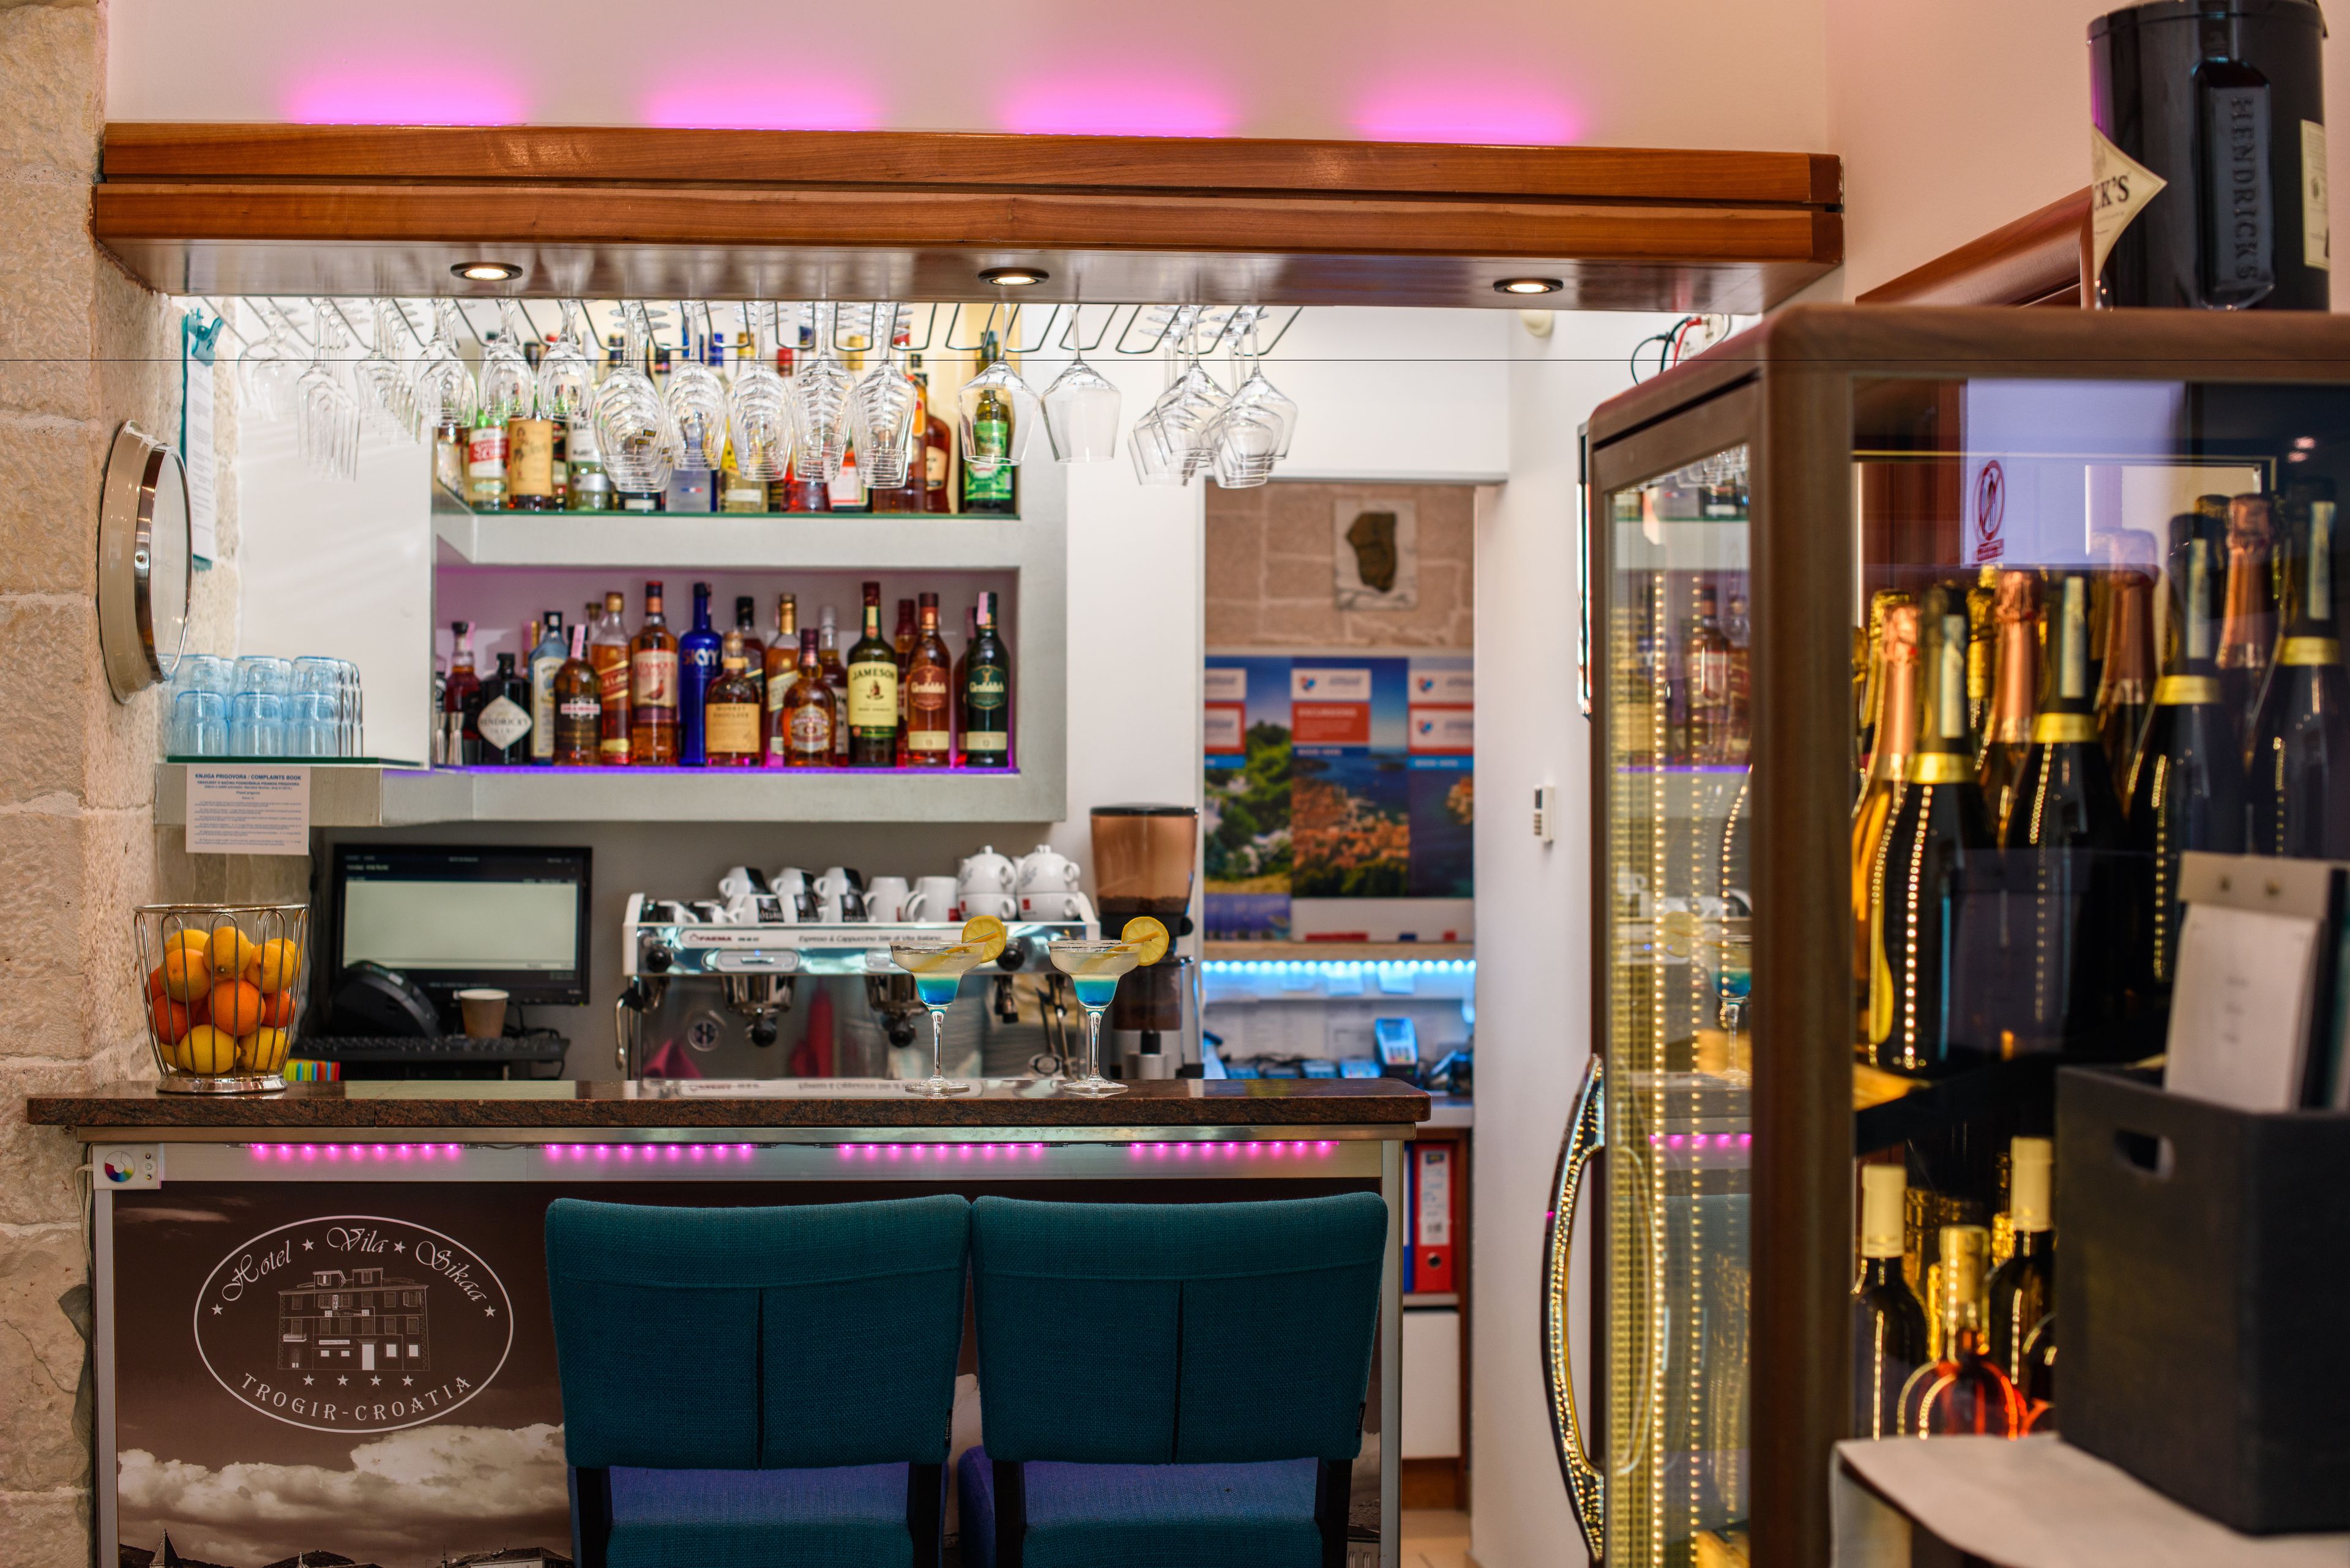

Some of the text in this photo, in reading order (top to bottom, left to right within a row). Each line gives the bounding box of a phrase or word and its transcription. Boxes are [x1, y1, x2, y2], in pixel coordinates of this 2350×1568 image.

[852, 667, 895, 681] JAMESON
[222, 1240, 293, 1302] Hotel
[326, 1226, 389, 1253] Vila
